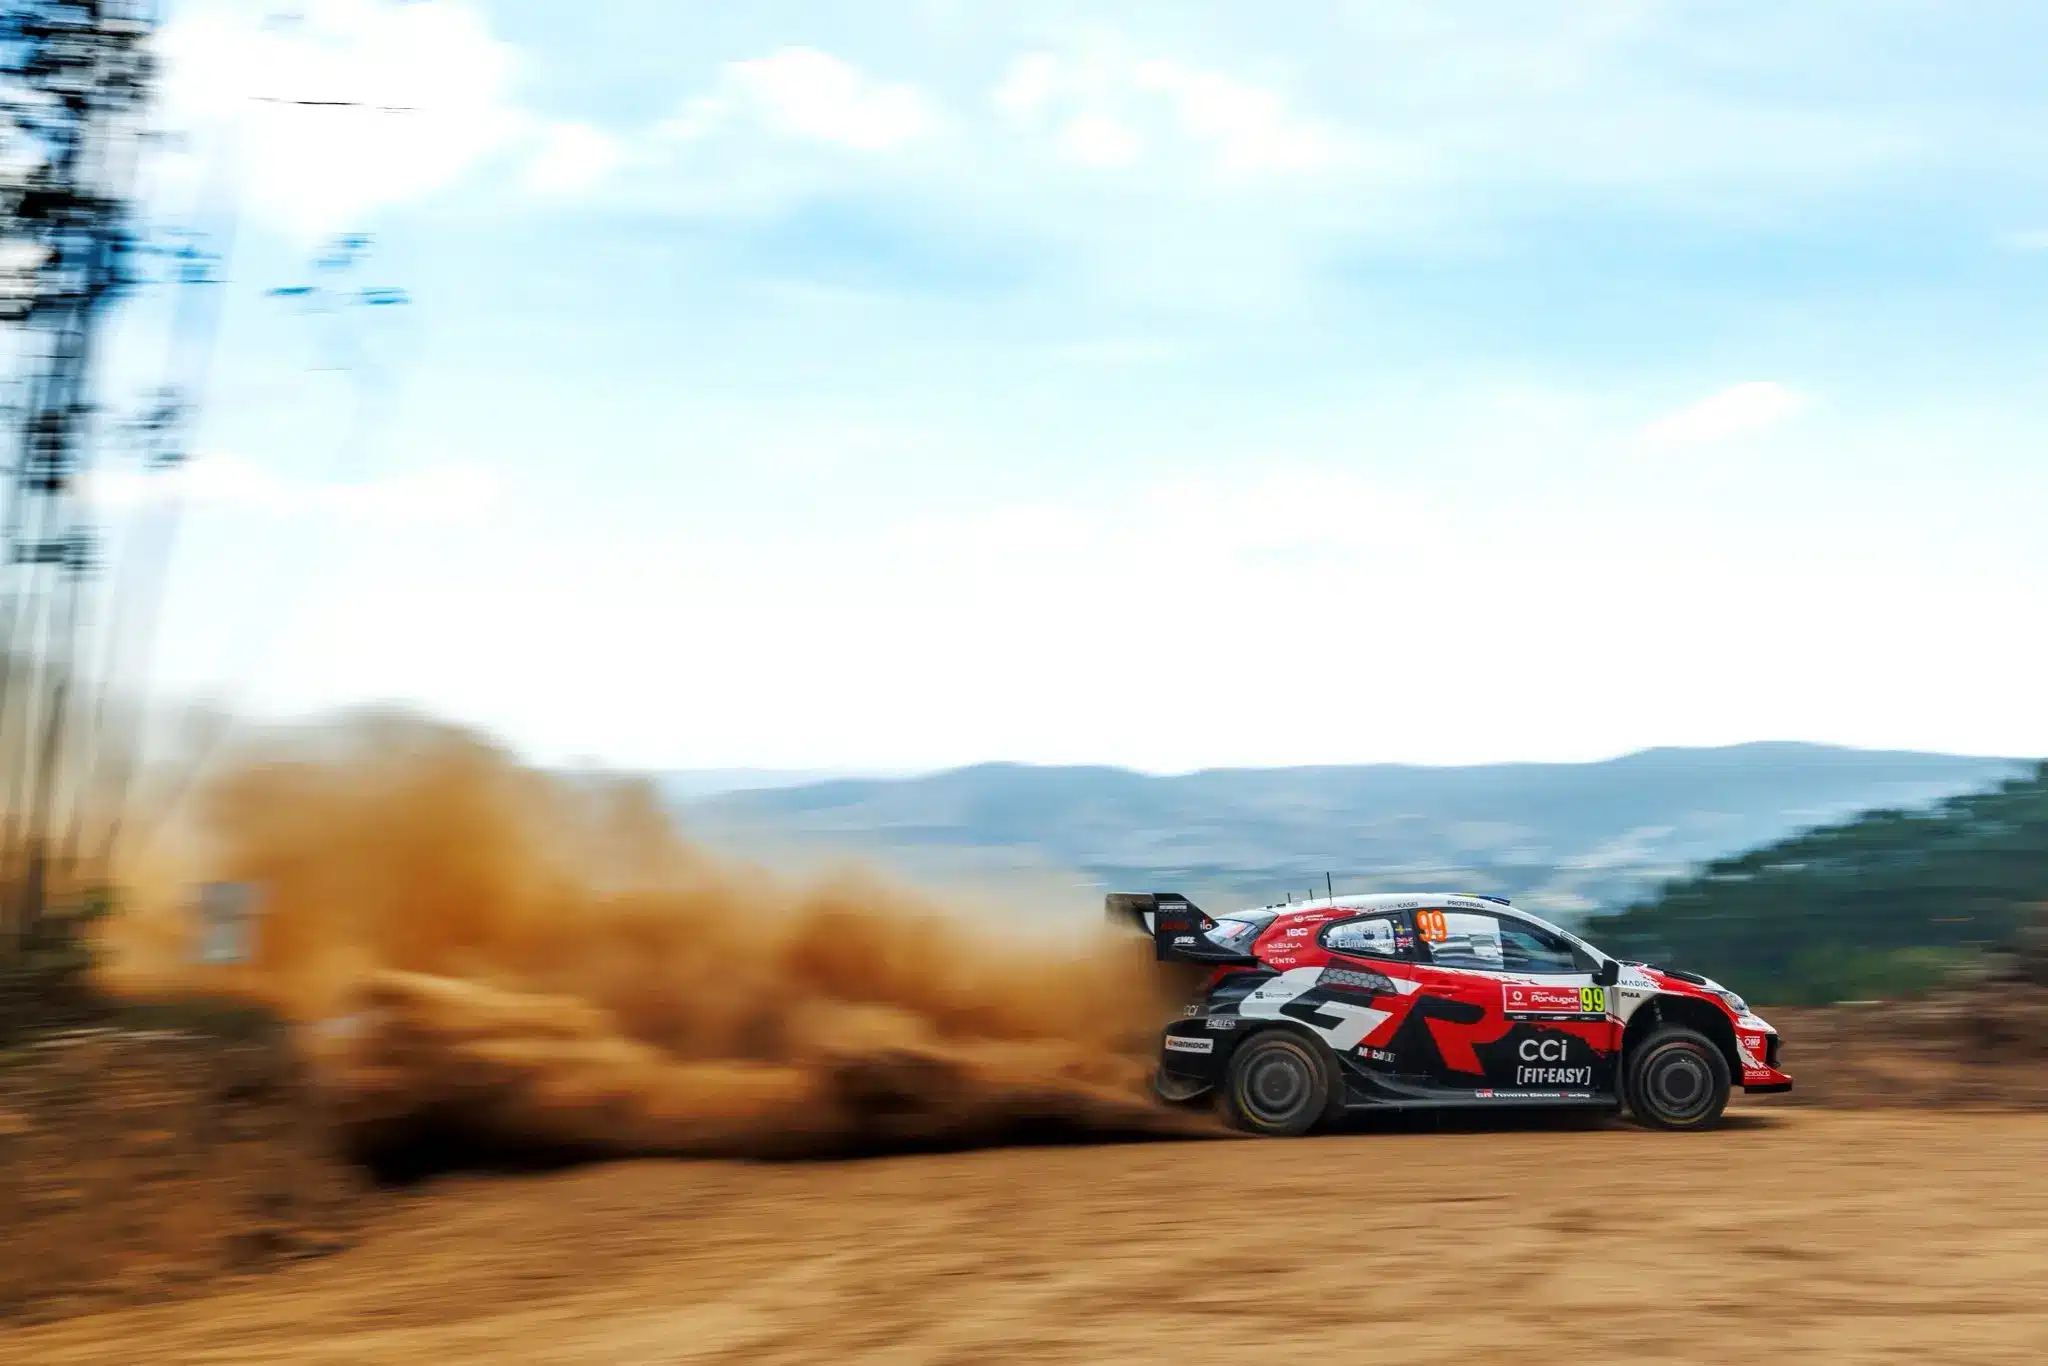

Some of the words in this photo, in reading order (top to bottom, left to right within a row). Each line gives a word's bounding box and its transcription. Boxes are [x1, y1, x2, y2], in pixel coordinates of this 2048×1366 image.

[1416, 910, 1447, 942] 99
[1531, 993, 1579, 1005] Portugal
[1582, 987, 1604, 1012] 99
[1621, 991, 1641, 999] PIAA
[1519, 1039, 1567, 1061] CCi
